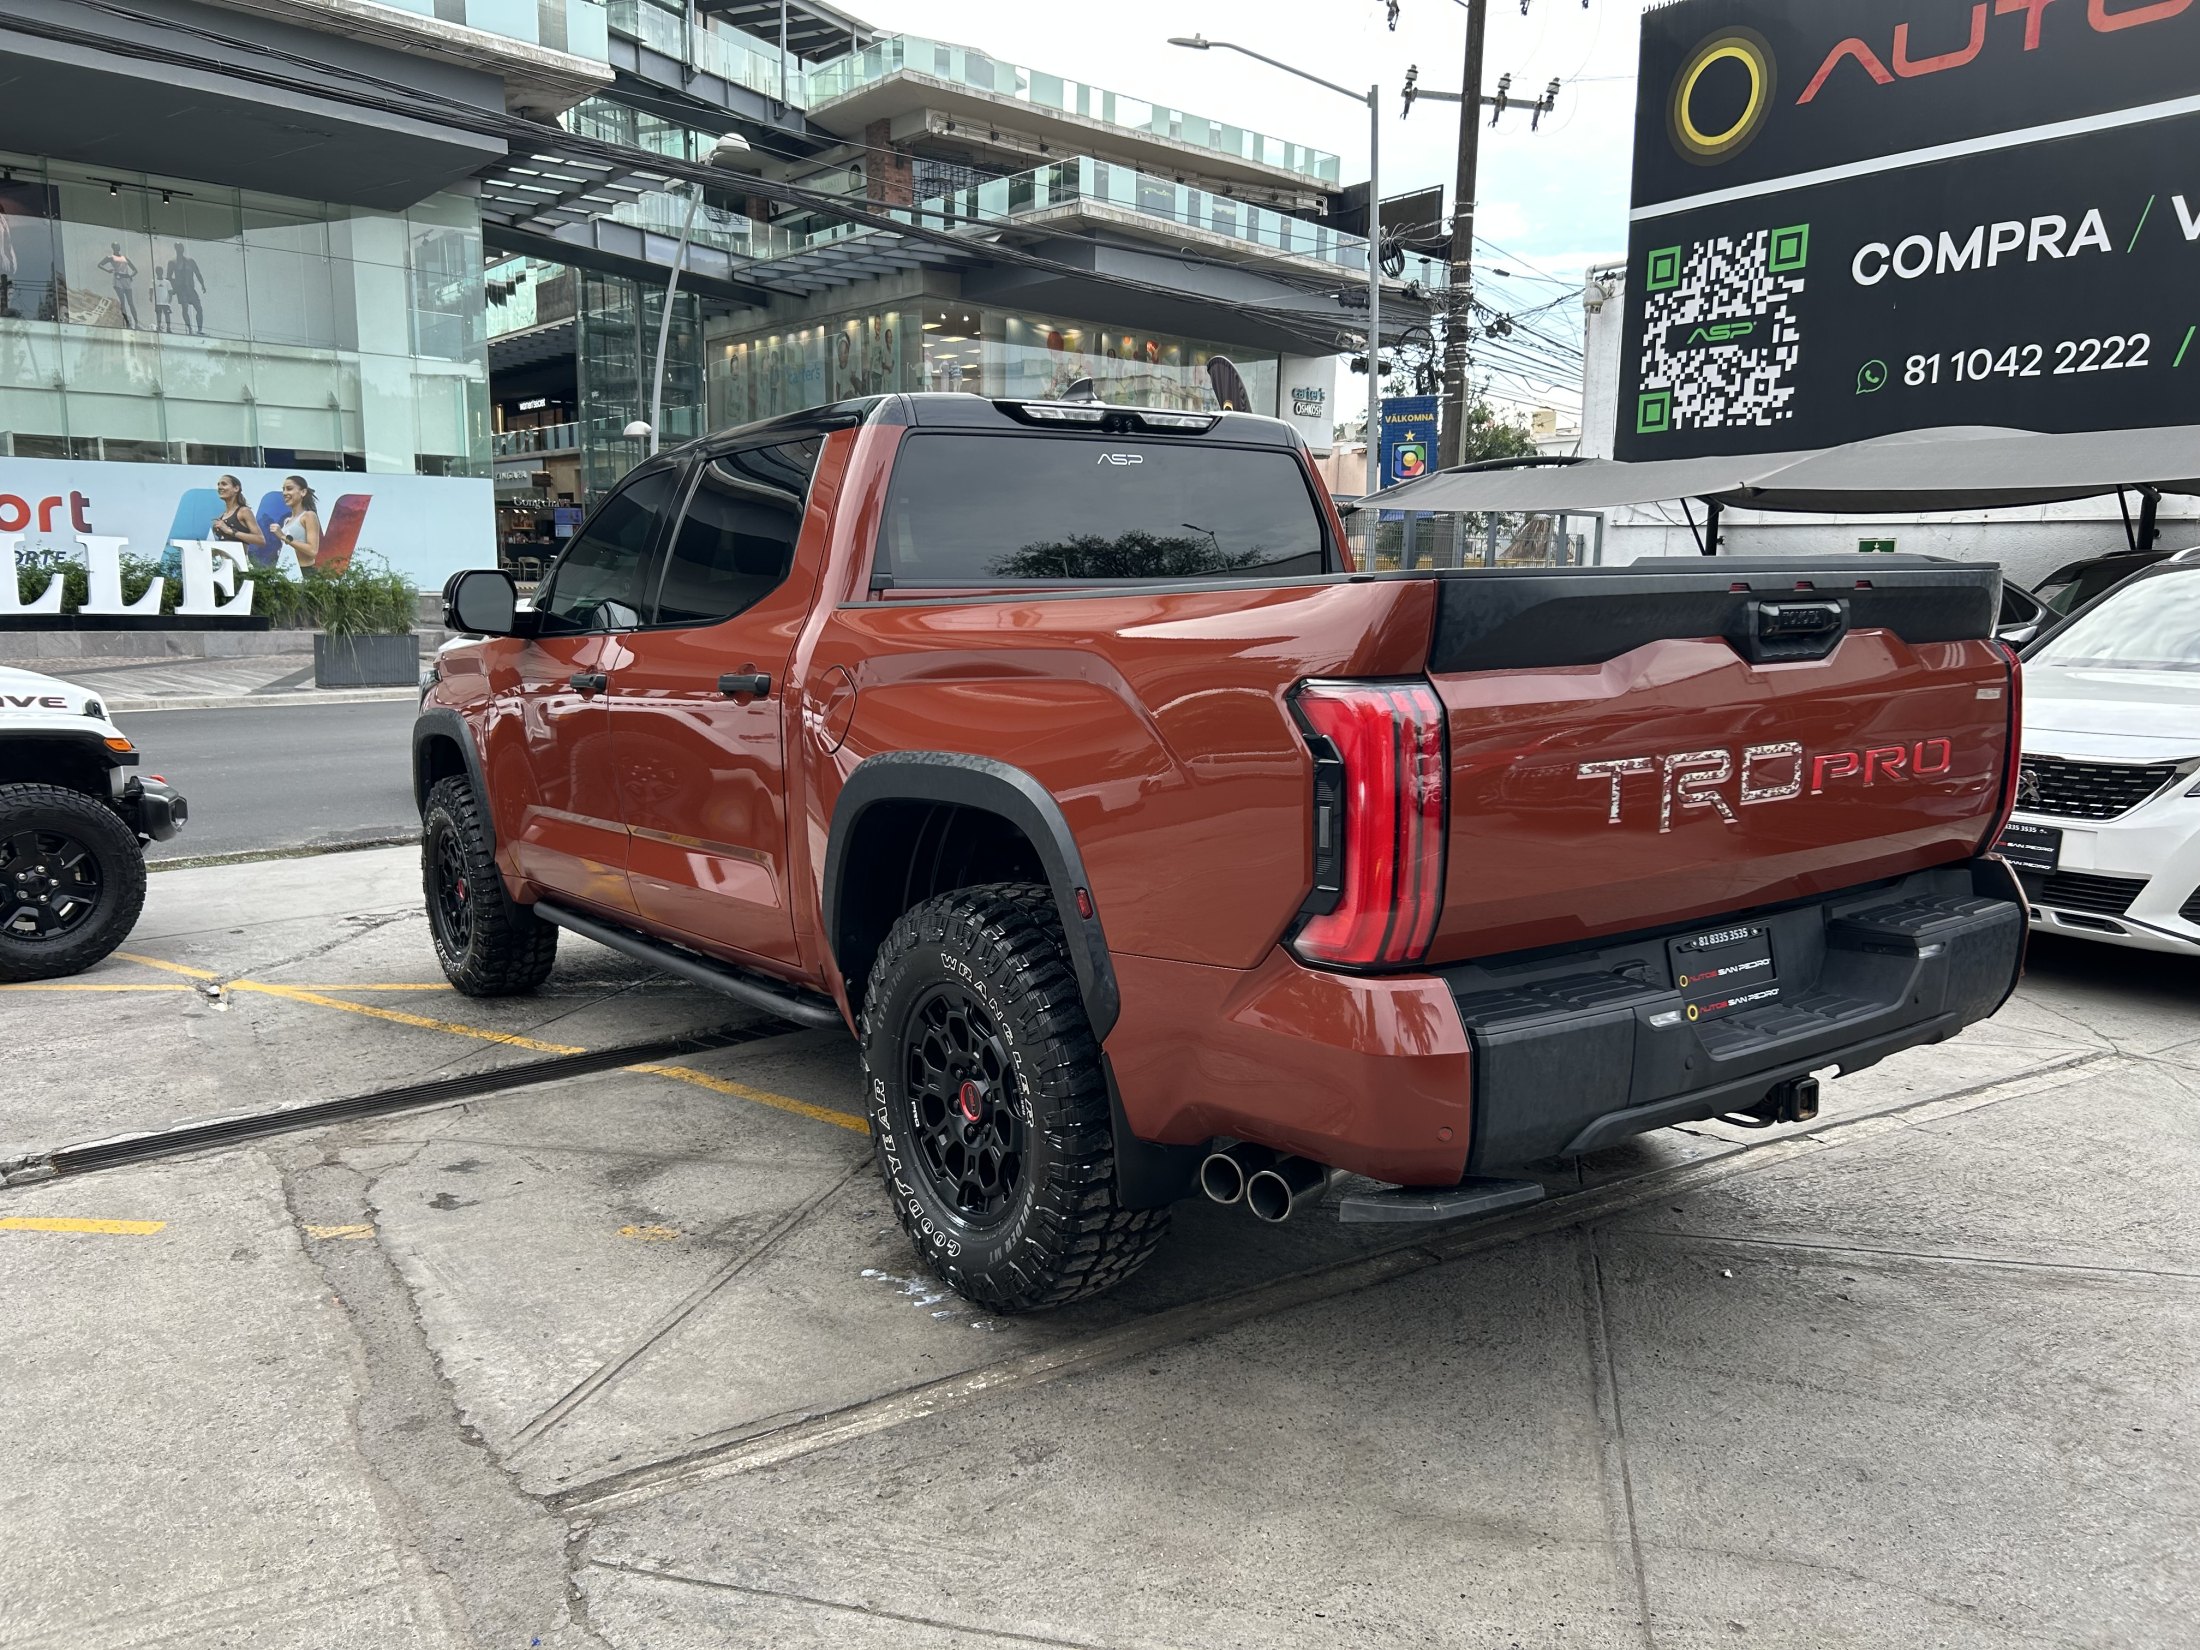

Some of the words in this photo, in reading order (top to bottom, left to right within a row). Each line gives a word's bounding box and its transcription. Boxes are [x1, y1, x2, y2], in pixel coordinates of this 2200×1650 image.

[1850, 208, 2112, 286] COMPRA
[1902, 353, 1940, 387] 81
[1951, 344, 2043, 383] 1042
[2053, 333, 2151, 376] 2222
[1097, 453, 1143, 466] ASP
[512, 496, 541, 509] Gong
[0, 533, 255, 615] LLE
[0, 695, 68, 708] VE
[1576, 740, 1803, 834] TRD
[1810, 736, 1952, 796] PRO
[2020, 825, 2037, 833] 3535
[1698, 936, 1709, 946] 81
[1709, 932, 1729, 944] 8335
[1730, 928, 1749, 941] 3535
[1718, 965, 1739, 975] SAN
[1738, 958, 1771, 971] PEDRO
[1728, 996, 1748, 1006] SAN
[1748, 988, 1780, 1001] PEDRO
[940, 952, 1035, 1128] WRANGLER
[874, 1078, 961, 1257] GOODYEAR
